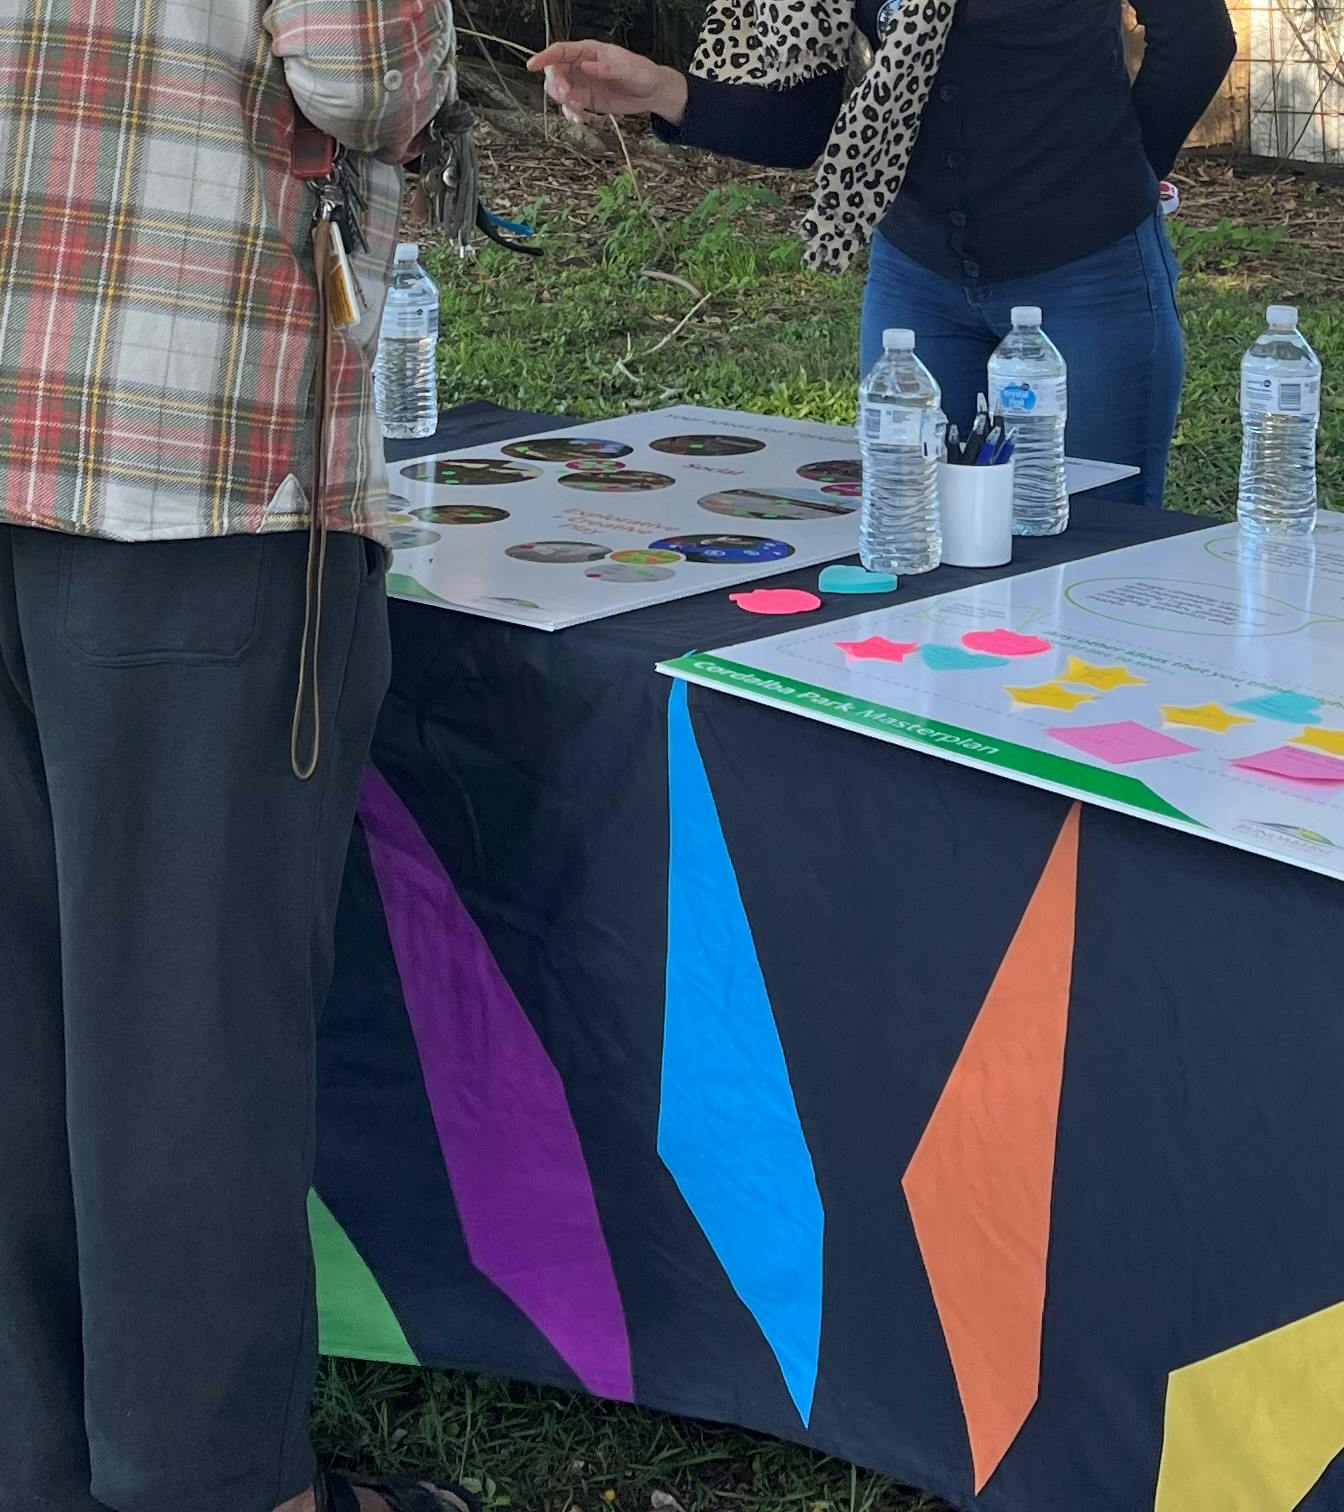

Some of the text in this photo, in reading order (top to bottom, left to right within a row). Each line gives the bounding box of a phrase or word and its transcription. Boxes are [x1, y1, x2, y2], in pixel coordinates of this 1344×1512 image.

[693, 660, 1001, 756] Cordalba Park Masterplan
